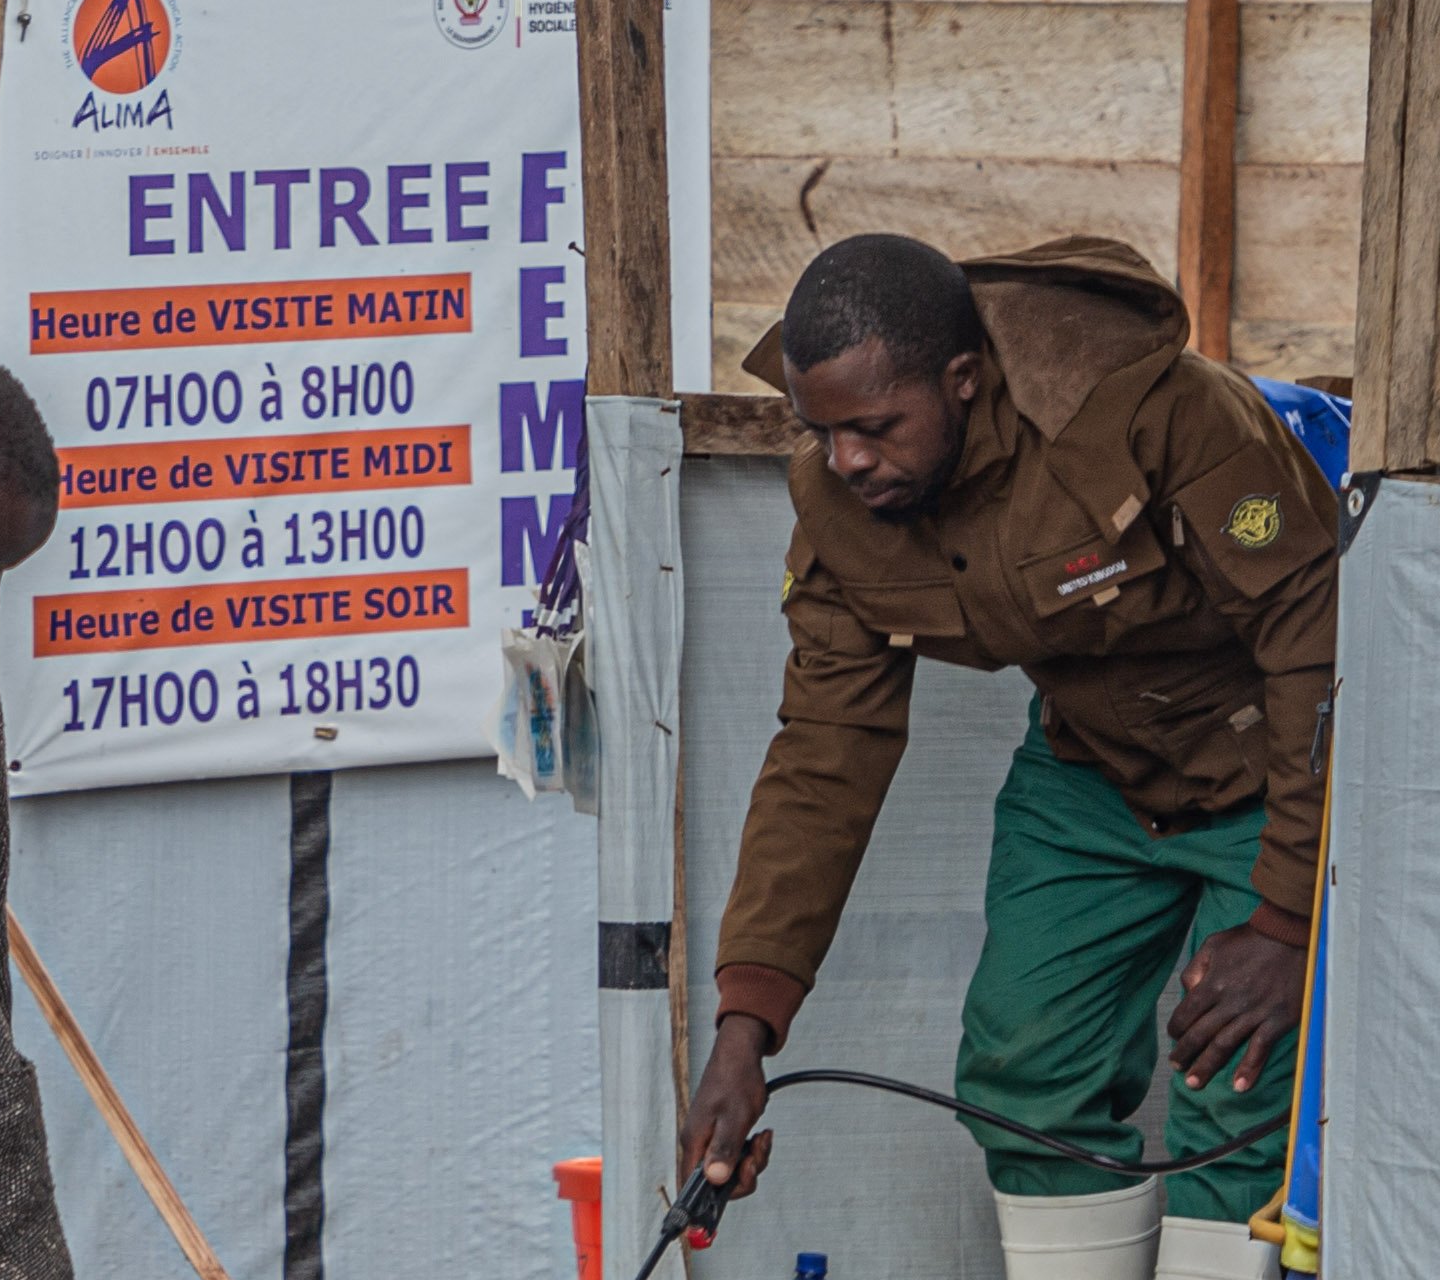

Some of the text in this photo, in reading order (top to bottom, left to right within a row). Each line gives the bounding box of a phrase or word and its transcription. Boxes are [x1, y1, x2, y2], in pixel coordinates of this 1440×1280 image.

[72, 88, 175, 133] ALIMA
[128, 160, 492, 257] ENTREE
[30, 287, 467, 341] Heure de VISITE MATIN
[259, 363, 284, 422] à
[498, 150, 587, 629] FEMM
[168, 456, 214, 490] de
[224, 447, 351, 488] VISITE
[362, 440, 455, 477] MIDI
[240, 509, 266, 569] à
[47, 583, 456, 642] Heure de VISITE SOIR
[236, 660, 261, 721] à
[277, 654, 422, 718] 18H30
